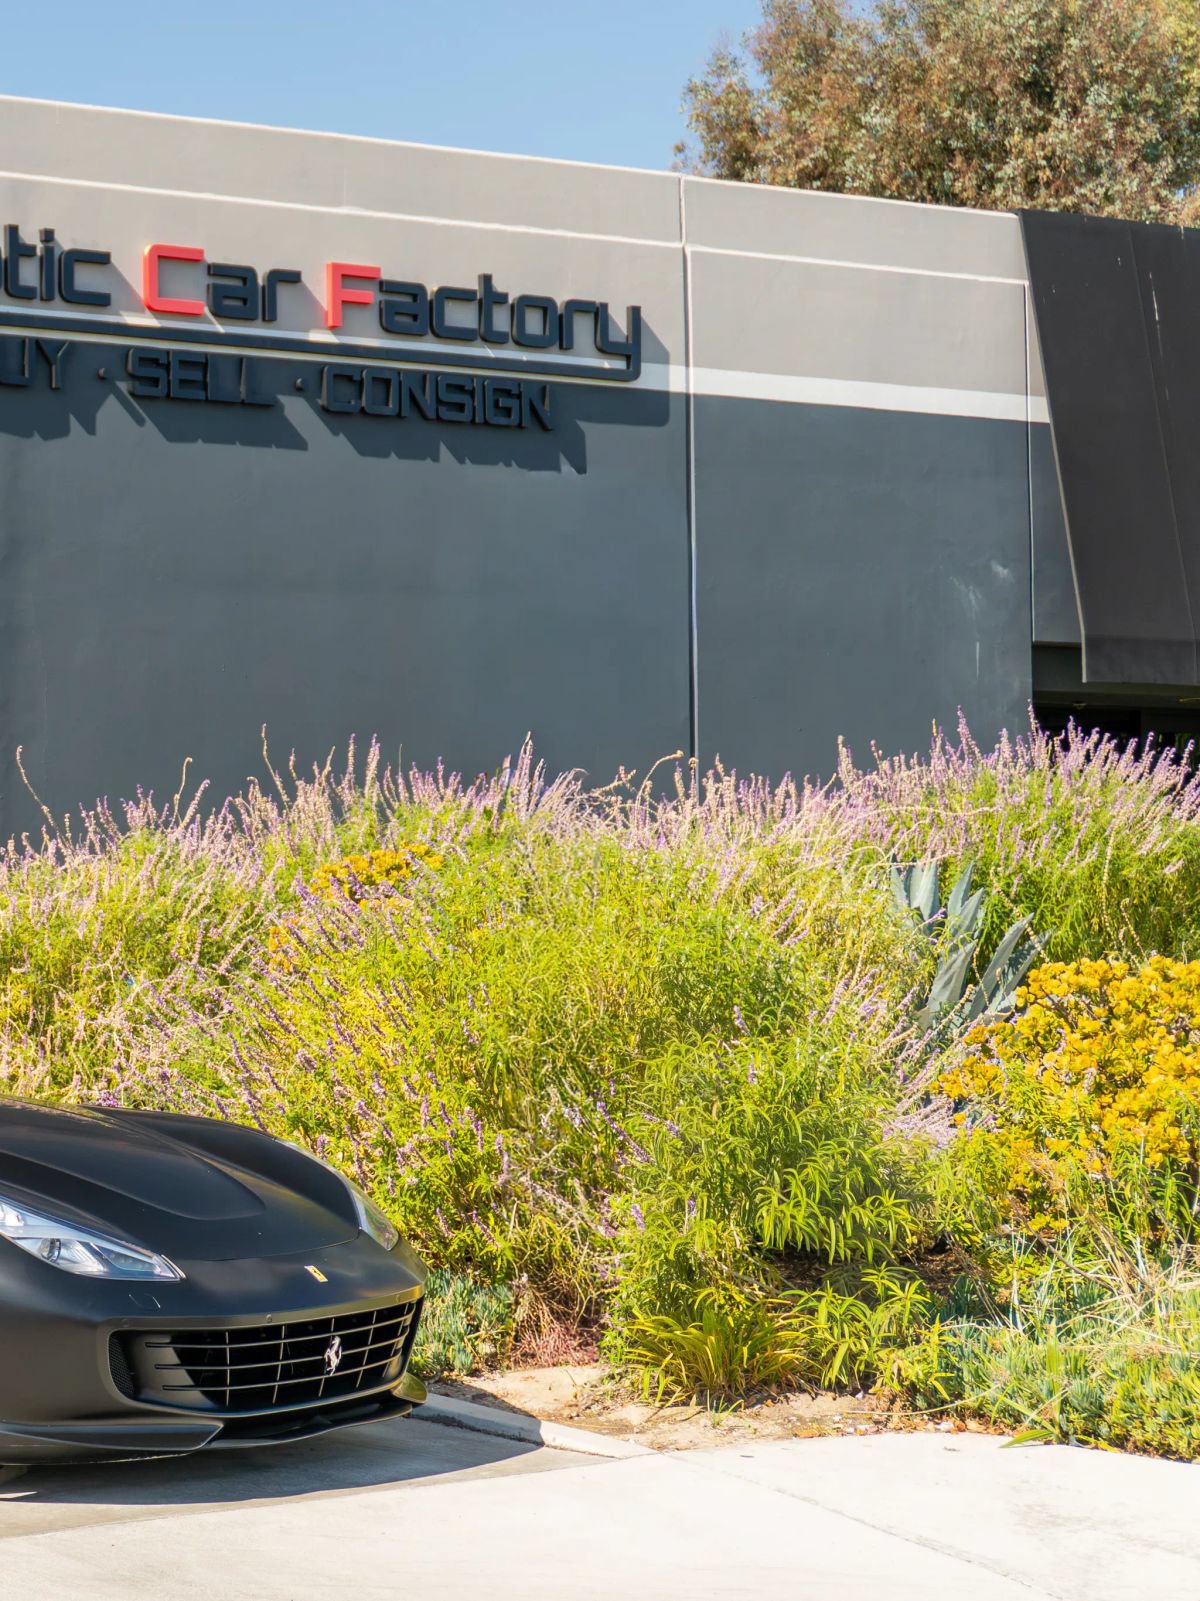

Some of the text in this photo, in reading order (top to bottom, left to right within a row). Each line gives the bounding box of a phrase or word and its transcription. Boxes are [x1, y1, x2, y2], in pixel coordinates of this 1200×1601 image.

[143, 243, 301, 321] Car
[326, 262, 641, 381] Factory
[127, 347, 276, 406] SELL
[322, 364, 553, 431] CONSIGN
